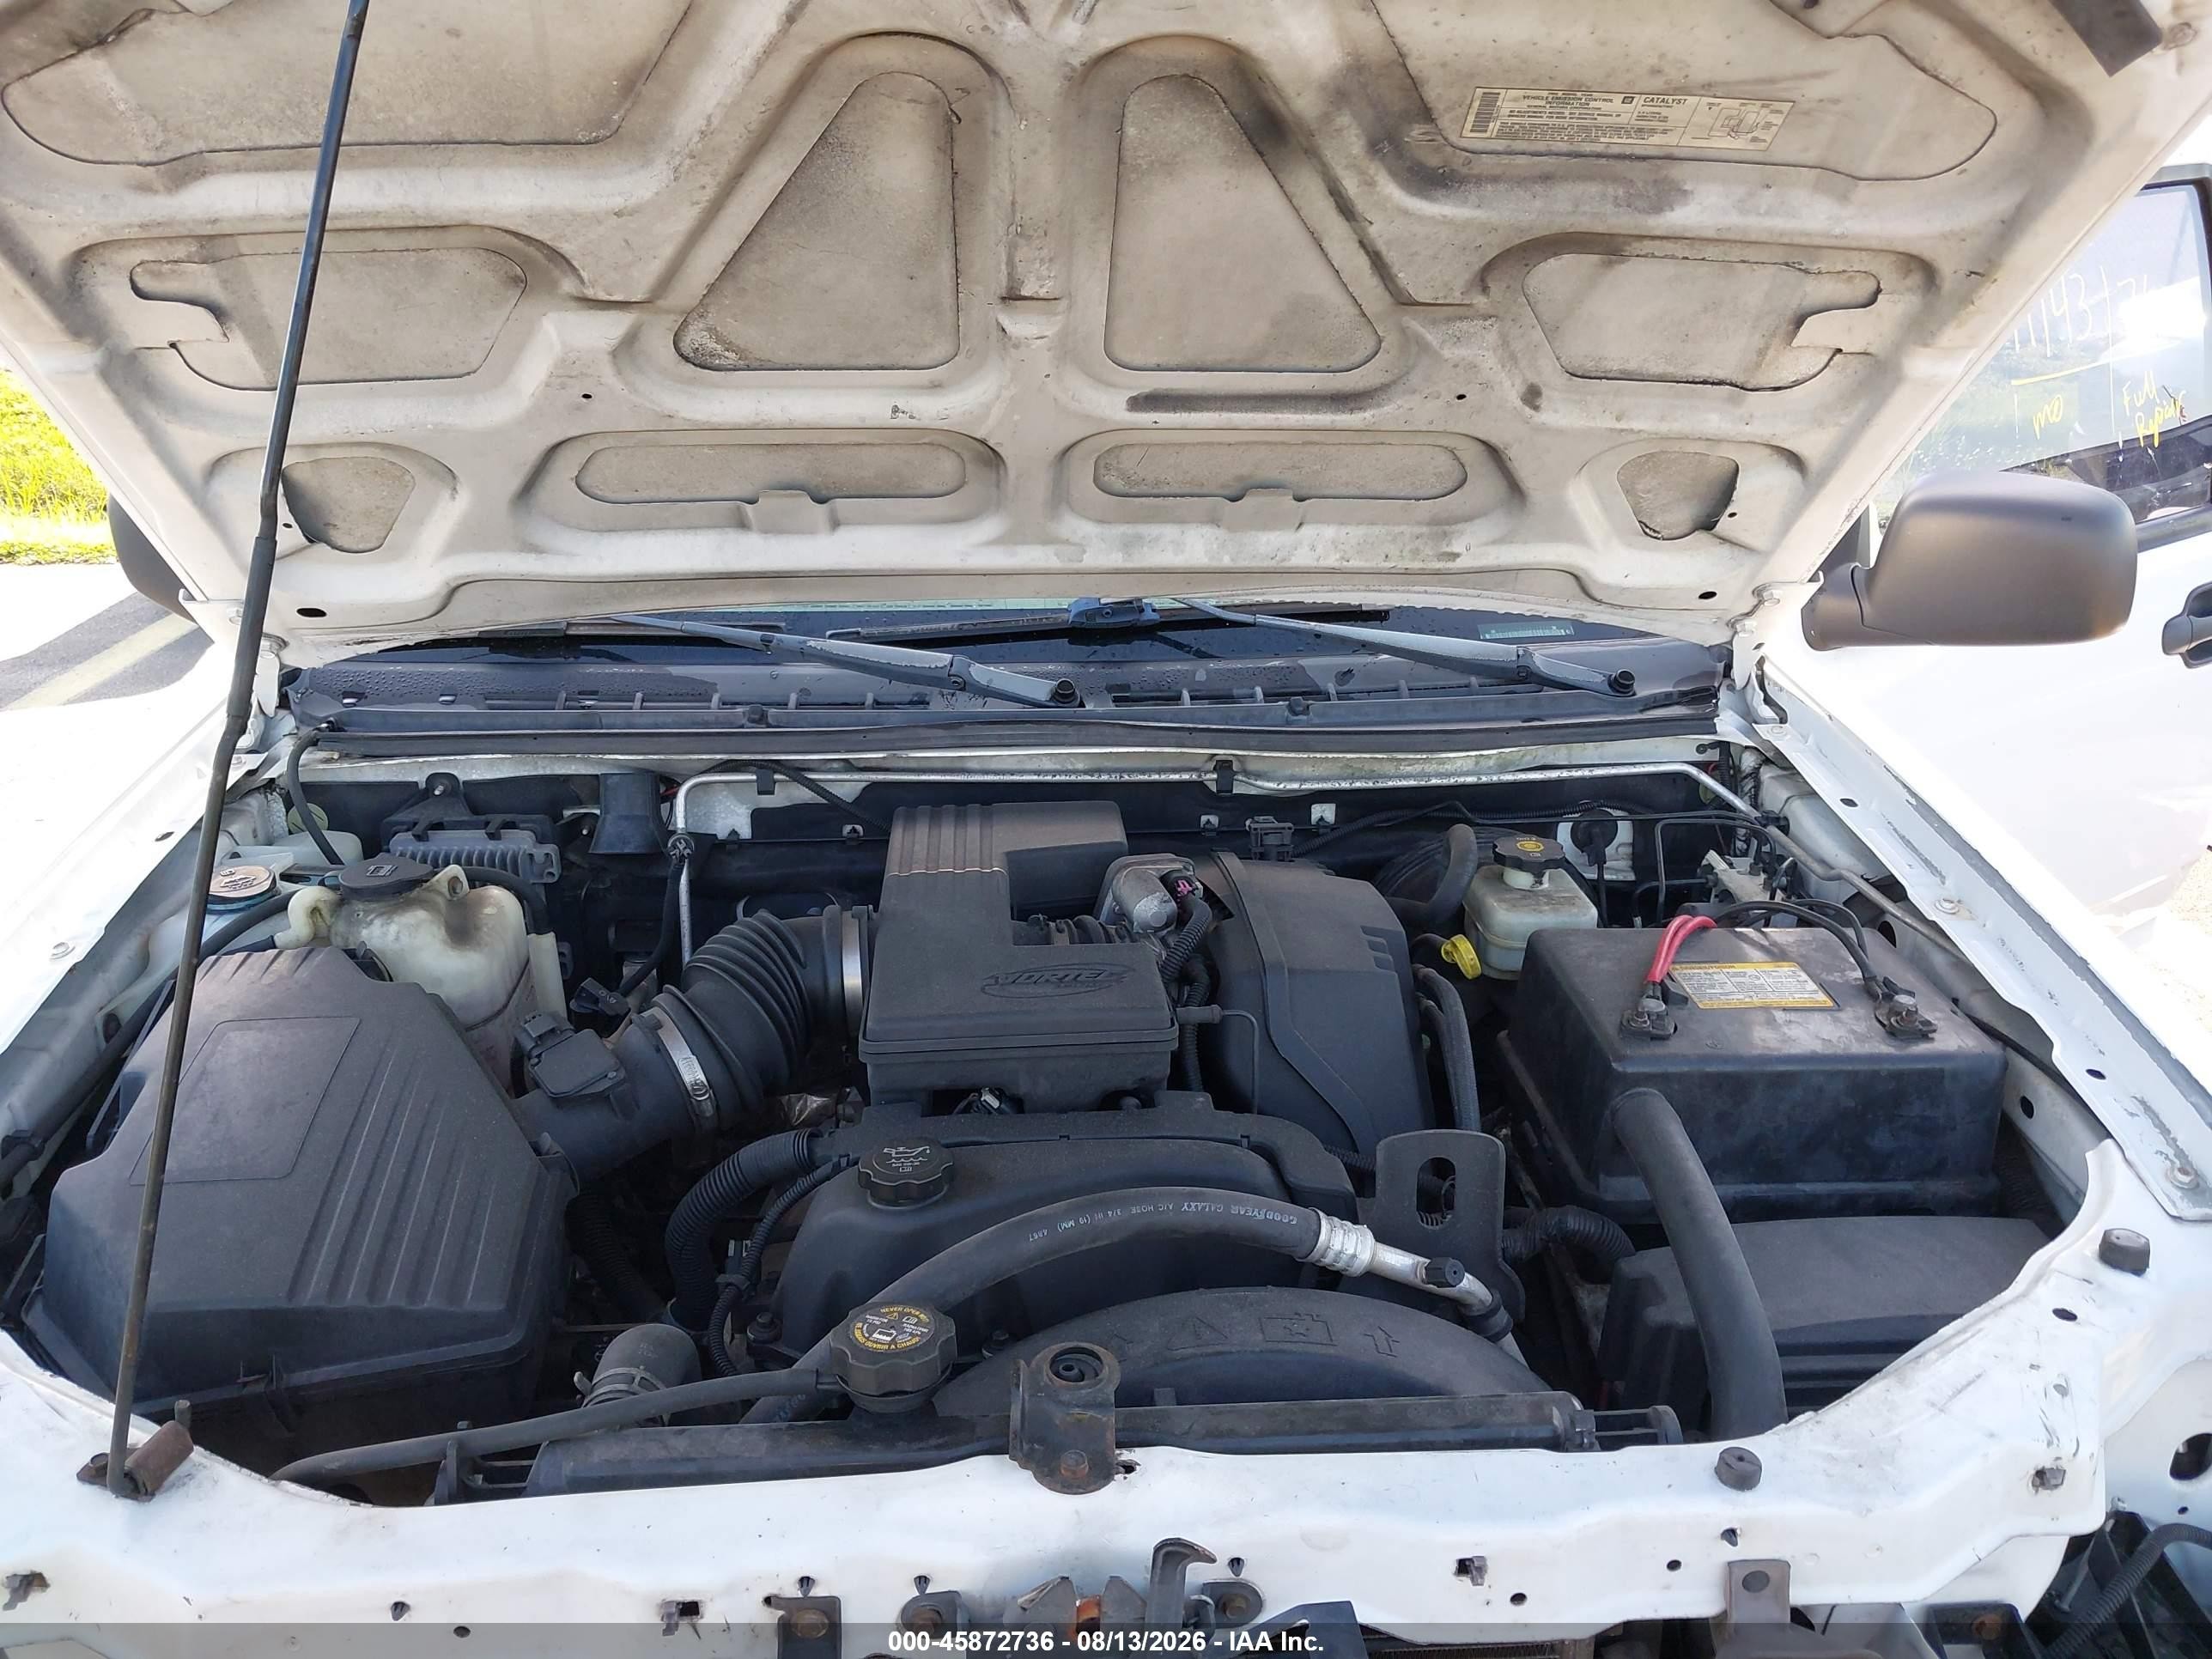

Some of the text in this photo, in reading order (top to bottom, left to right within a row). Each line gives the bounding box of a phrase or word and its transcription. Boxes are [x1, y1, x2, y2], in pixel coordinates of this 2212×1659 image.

[1643, 96, 1688, 105] CATALYST
[1130, 1204, 1154, 1214] HOSE
[1158, 1203, 1173, 1212] A/C
[1182, 1202, 1224, 1212] GALAXY
[1231, 1205, 1298, 1224] GOODYEAR
[1057, 1219, 1076, 1232] MM)
